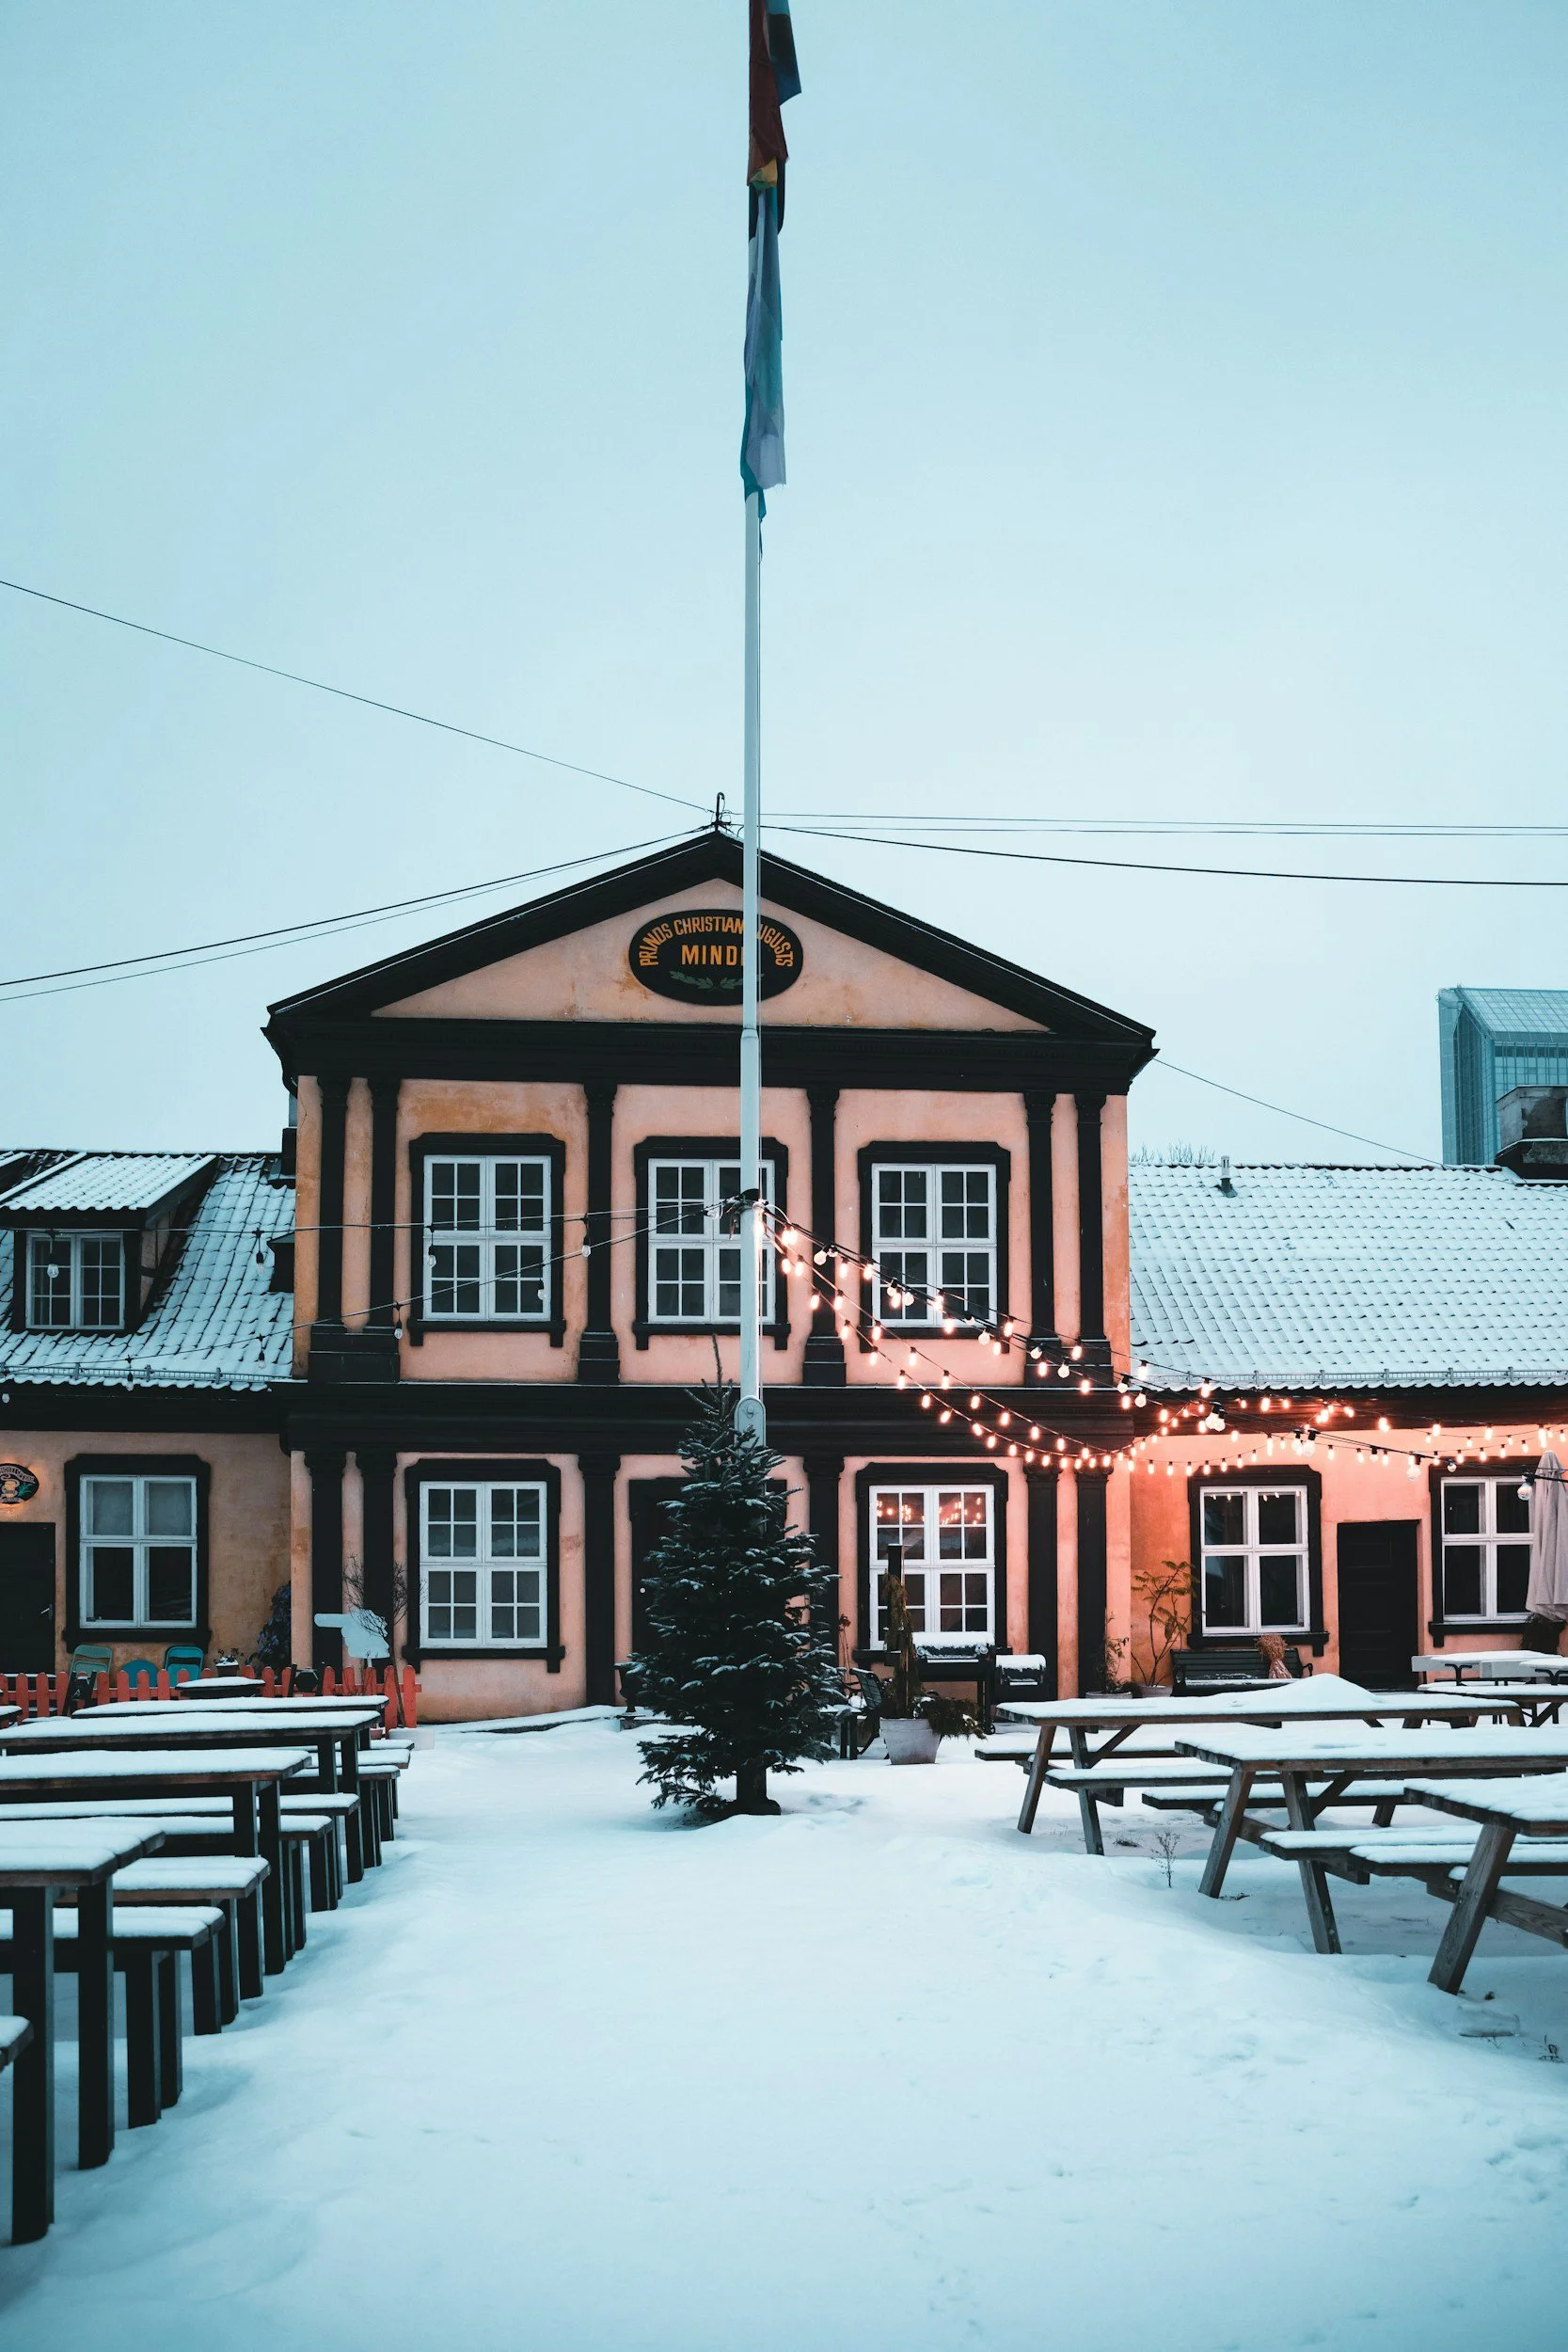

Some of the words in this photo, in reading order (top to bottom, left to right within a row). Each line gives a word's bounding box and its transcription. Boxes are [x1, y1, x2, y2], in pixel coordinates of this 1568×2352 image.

[639, 923, 673, 966] PRINDS
[673, 916, 744, 936] CHRISTIAN
[755, 923, 794, 967] UGUSTS
[681, 945, 744, 965] MIND
